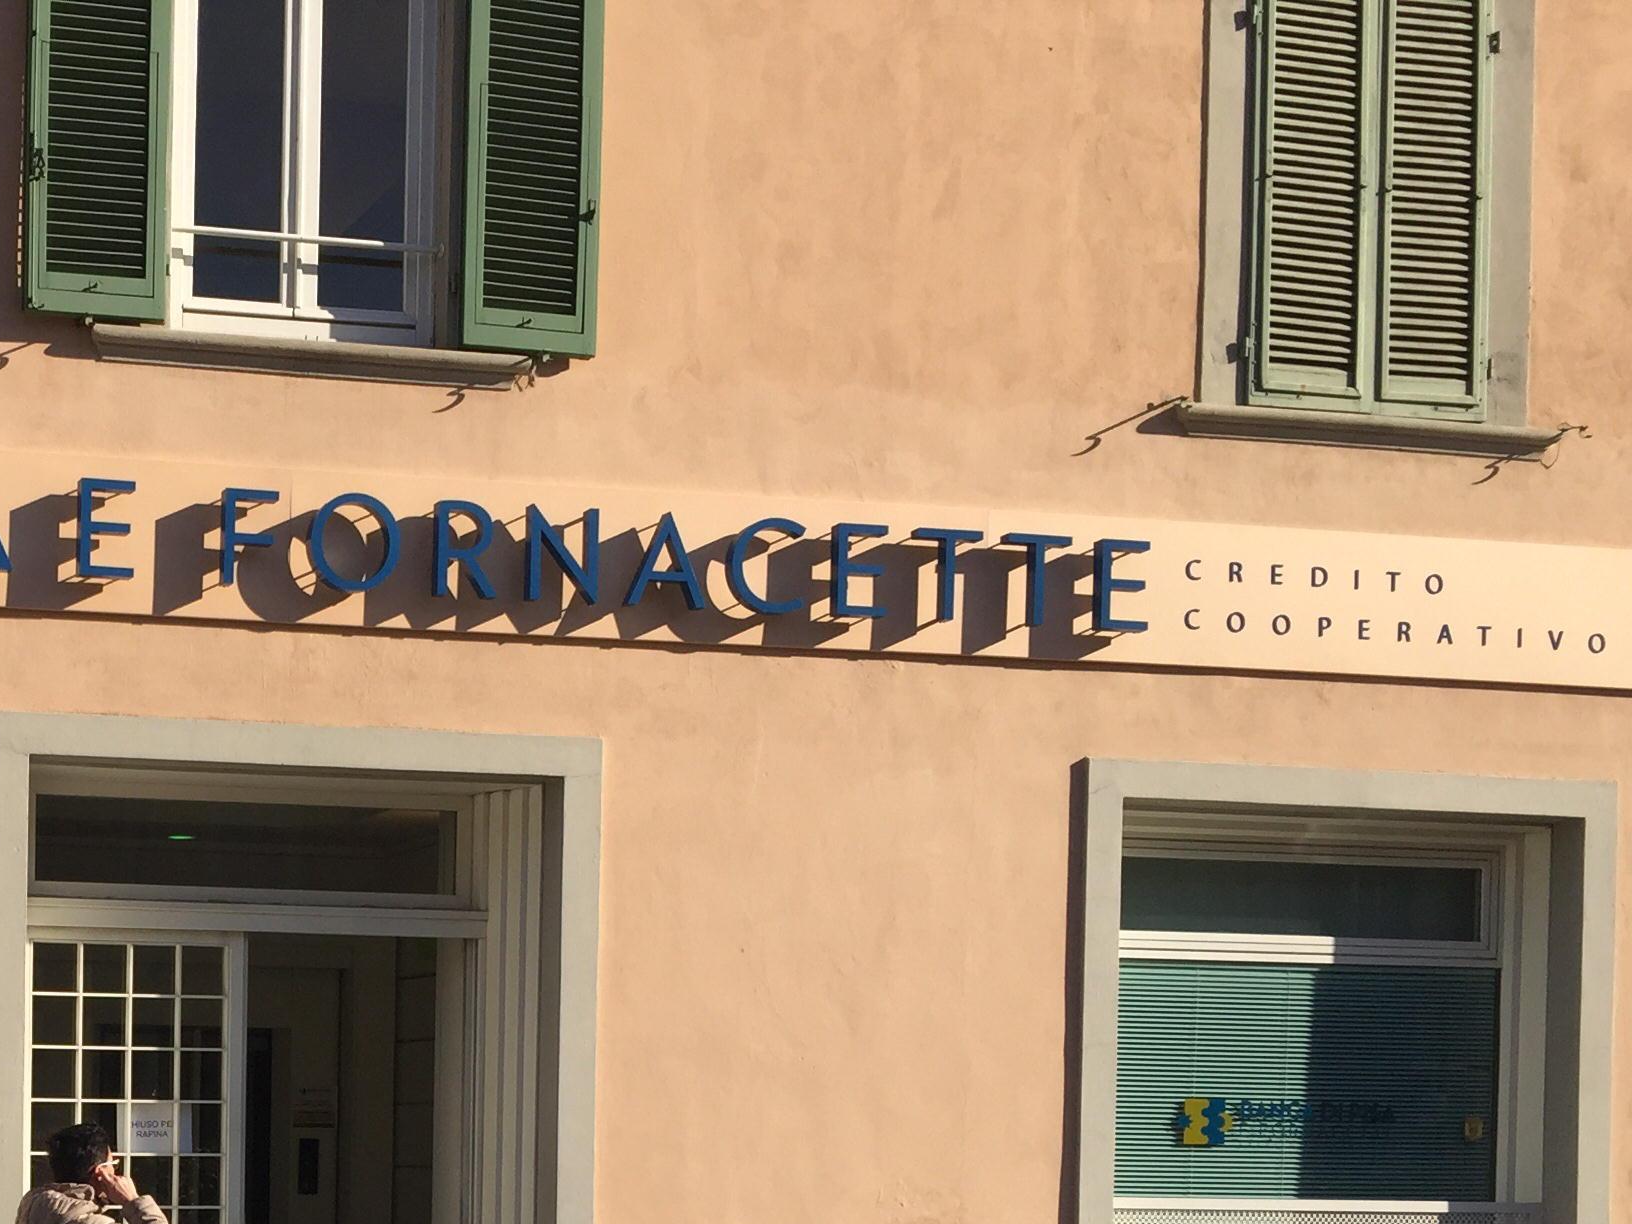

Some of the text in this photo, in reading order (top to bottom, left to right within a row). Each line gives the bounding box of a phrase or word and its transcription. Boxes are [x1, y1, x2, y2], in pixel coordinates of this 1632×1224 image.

[76, 477, 136, 579] E
[219, 487, 1151, 632] FORNACETTE
[1184, 559, 1444, 595] CREDITO
[1183, 608, 1607, 654] COOPERATIVO
[131, 1120, 159, 1129] HIUSO
